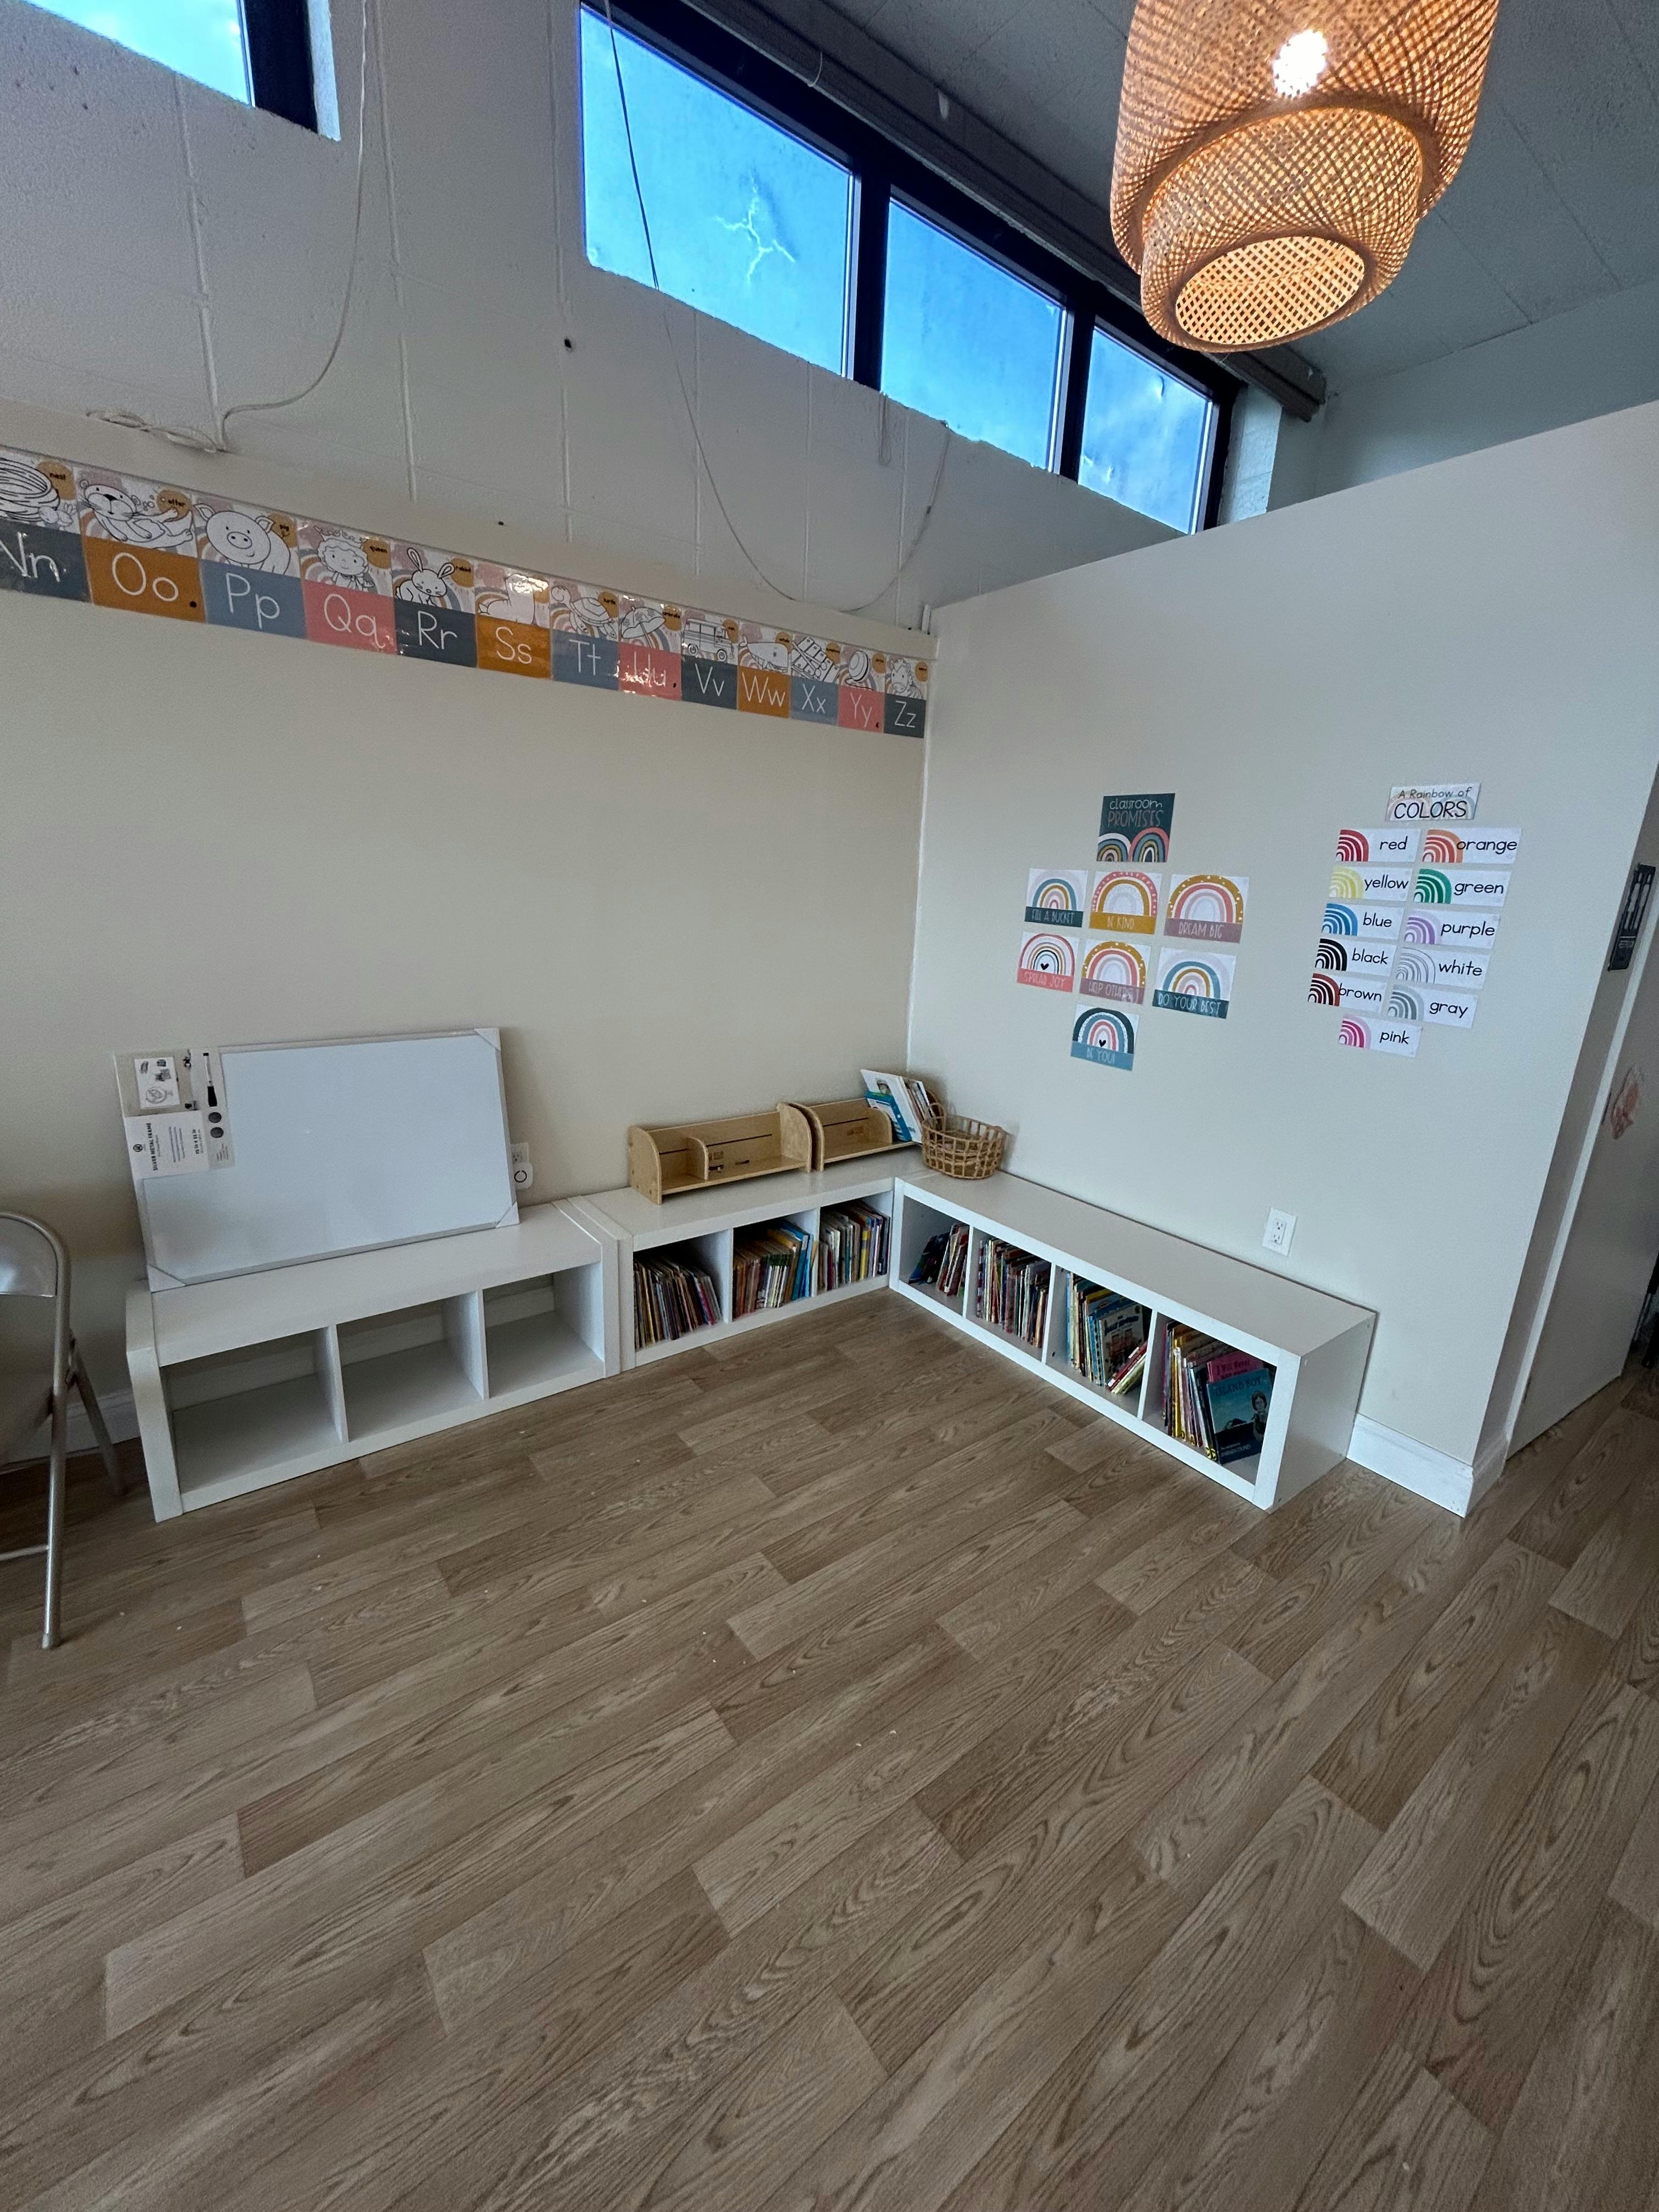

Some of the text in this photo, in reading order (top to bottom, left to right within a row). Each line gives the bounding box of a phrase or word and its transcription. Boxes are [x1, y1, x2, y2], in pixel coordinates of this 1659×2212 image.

[112, 552, 178, 601] Oo
[225, 572, 280, 629] Pp
[324, 594, 385, 649] Qq
[418, 610, 458, 650] Rr
[496, 626, 532, 664] Ss
[569, 639, 601, 676] Tt
[695, 663, 725, 696] Vv
[742, 672, 786, 707] Ww
[802, 683, 826, 713] Xx
[850, 692, 872, 727] Yy
[895, 700, 916, 728] Zz
[1398, 787, 1472, 799] A Rainbow of
[1109, 798, 1163, 809] classroom
[1394, 800, 1467, 819] COLORS
[1108, 810, 1163, 828] PROMISES
[1379, 836, 1408, 850] red
[1457, 840, 1517, 854] orange
[1364, 874, 1409, 891] yellow
[1454, 881, 1504, 896] green
[1043, 910, 1049, 922] A
[1117, 916, 1135, 930] KIND
[1363, 912, 1392, 927] blue
[1178, 922, 1224, 939] DREAM BIG
[1441, 921, 1495, 938] purple
[1352, 948, 1388, 964] black
[1438, 960, 1482, 976] white
[1048, 975, 1066, 988] JOY
[1338, 983, 1381, 1002] brown
[1158, 993, 1221, 1016] DO YOUR BEST
[1429, 1001, 1468, 1018] gray
[1379, 1030, 1409, 1044] pink
[1215, 1375, 1261, 1396] ISLAND BOY
